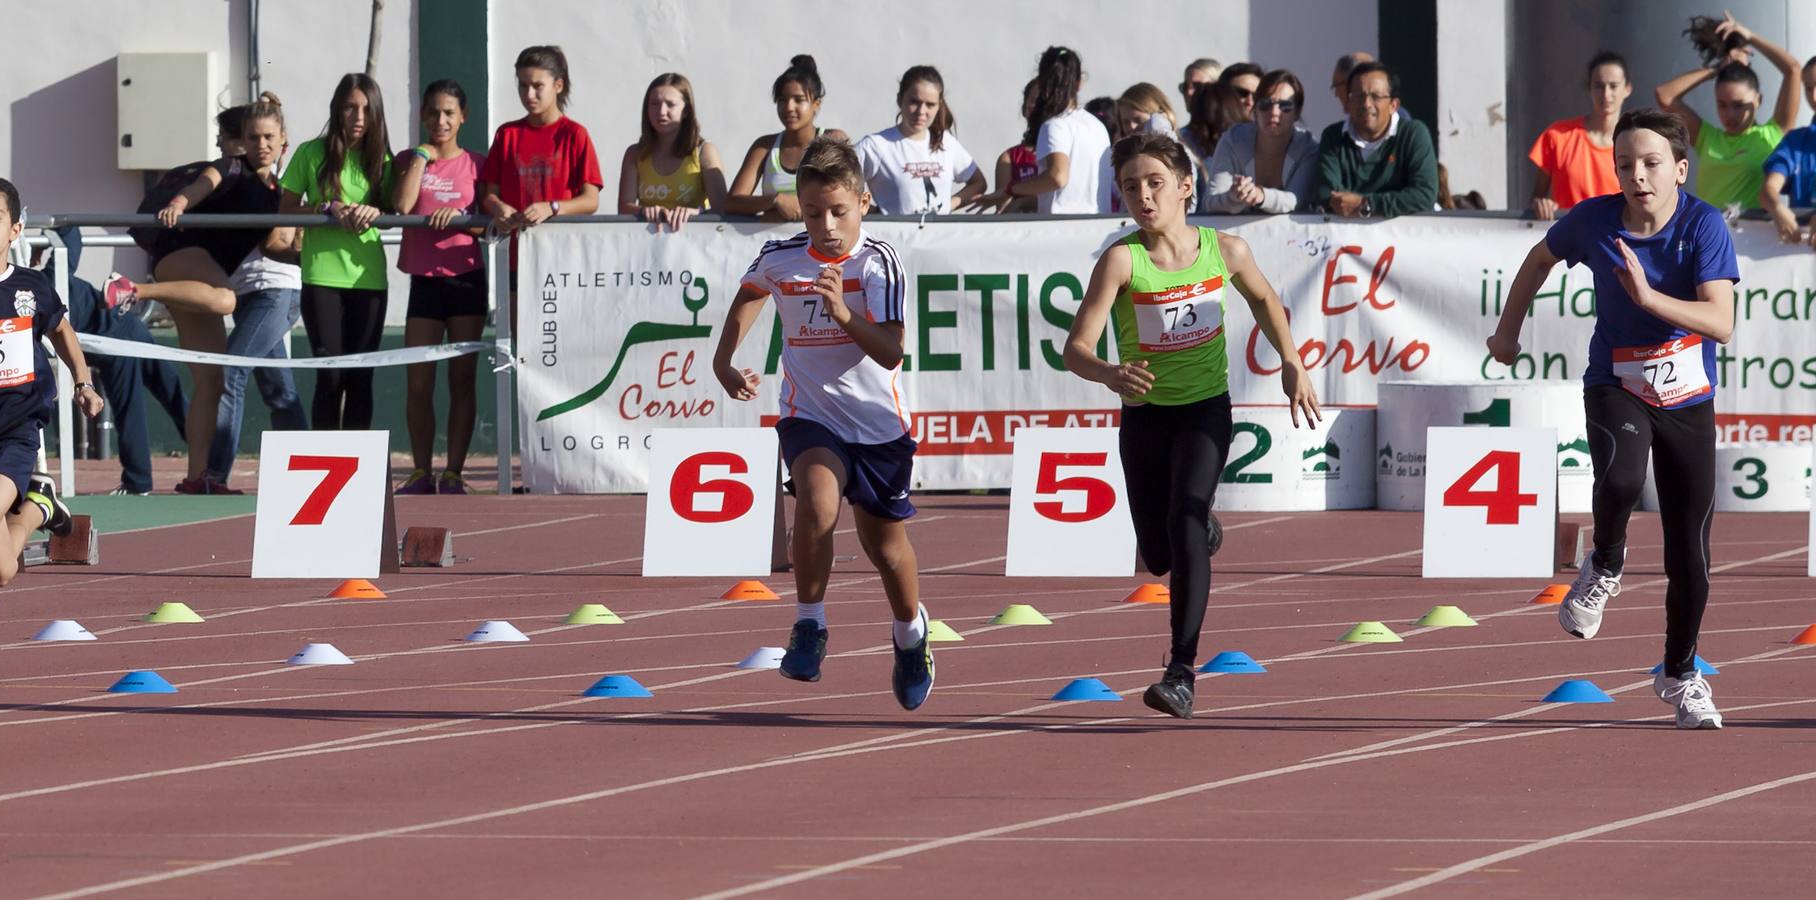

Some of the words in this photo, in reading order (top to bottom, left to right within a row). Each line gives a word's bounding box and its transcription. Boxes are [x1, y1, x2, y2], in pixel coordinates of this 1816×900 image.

[544, 270, 692, 287] ATLETISMO
[1321, 246, 1395, 316] El
[543, 290, 557, 314] DE
[803, 300, 831, 324] 74
[1165, 303, 1197, 331] 73
[543, 320, 557, 367] CLUB
[1160, 326, 1210, 343] Alcampo
[1246, 305, 1430, 376] Corvo
[657, 350, 696, 389] El
[1643, 361, 1677, 388] 72
[1716, 347, 1816, 390] tros
[619, 384, 715, 420] Corvo
[1219, 422, 1273, 483] 2
[1396, 451, 1426, 464] Gobier
[287, 455, 359, 525] 7
[670, 451, 754, 523] 6
[1033, 451, 1116, 523] 5
[1442, 450, 1538, 525] 4
[1732, 457, 1768, 500] 3
